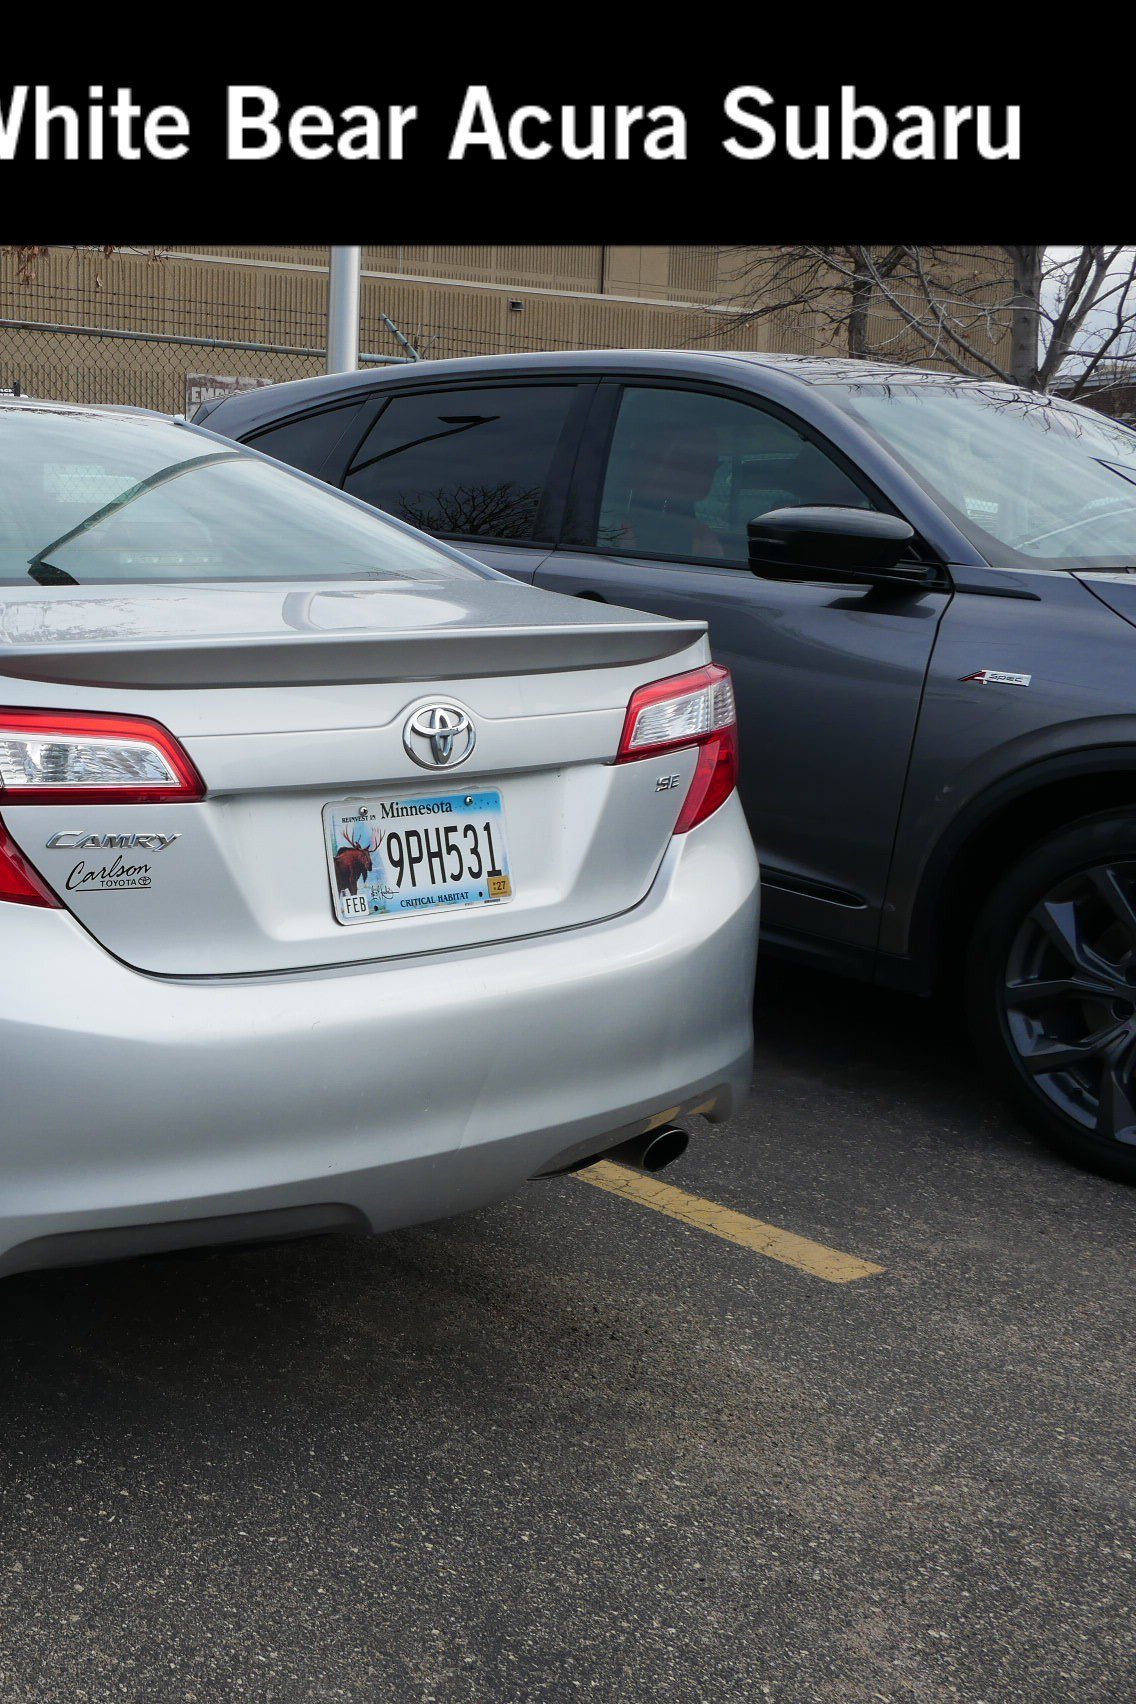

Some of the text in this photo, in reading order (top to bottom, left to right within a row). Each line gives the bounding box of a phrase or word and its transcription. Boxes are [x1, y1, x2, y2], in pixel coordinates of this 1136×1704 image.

[655, 773, 681, 792] SE
[380, 801, 453, 819] Minnesota
[45, 830, 183, 852] CAMRY
[386, 821, 503, 889] 9PH531
[65, 854, 152, 891] Carlson
[99, 878, 137, 888] TOYOTA
[496, 880, 506, 891] 27
[346, 896, 367, 914] FEB
[400, 891, 469, 908] CRITICAL HABITAT
